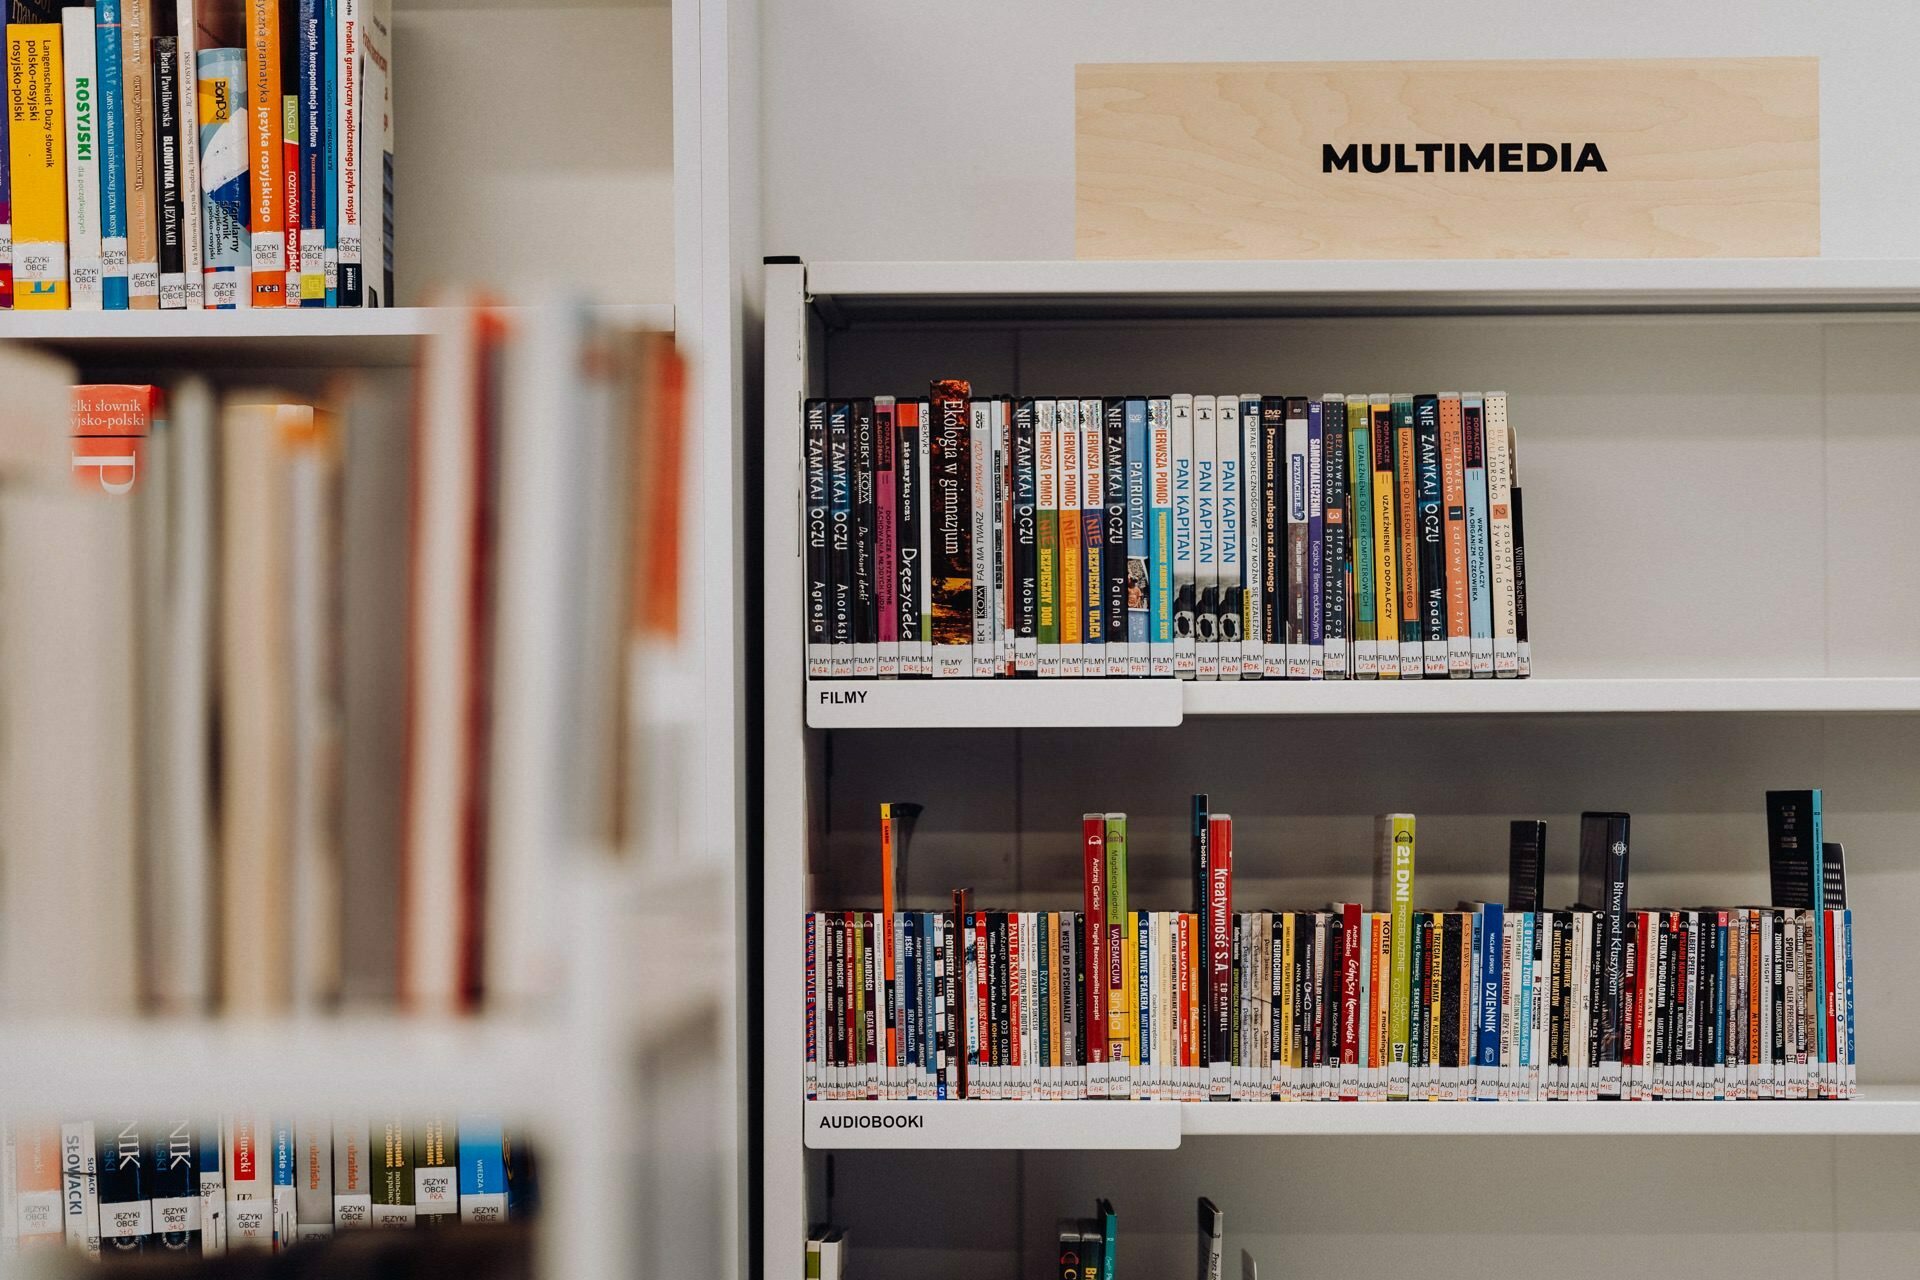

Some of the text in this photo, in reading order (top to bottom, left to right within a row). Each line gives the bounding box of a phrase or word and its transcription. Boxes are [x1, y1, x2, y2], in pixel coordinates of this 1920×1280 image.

[309, 19, 318, 50] Rosyjska
[346, 21, 355, 55] Poradnik
[11, 40, 25, 122] rosyjsko-polski
[26, 40, 40, 121] polsko-rosyjski
[42, 40, 55, 168] Langenscheidt Duży słownik
[308, 52, 318, 109] korespondencja
[345, 57, 355, 106] gramatyczny
[76, 77, 92, 161] ROSYJSKI
[256, 40, 273, 223] gramatyka języka rosyjskiego
[287, 100, 296, 134] LINGEA
[309, 111, 319, 147] handlowa
[345, 109, 357, 167] współczesnego
[160, 51, 176, 245] Beata Pawlikowska BLONDYNKA NA JĘZYKACH
[1322, 143, 1608, 173] MULTIMEDIA
[288, 170, 299, 223] rozmówki
[345, 168, 356, 194] języka
[215, 200, 223, 256] rosyjsko-polski
[231, 200, 240, 253] Popularny
[73, 268, 99, 276] JĘZYKI
[134, 280, 156, 288] OBCE
[95, 399, 141, 412] słownik
[859, 417, 870, 504] PROJEKT KOM
[937, 400, 964, 555] Ekologia w gimnazjum
[1249, 416, 1259, 529] PORTALE SPOŁECZNOŚCIOWE
[1265, 428, 1276, 480] Przemiana
[1310, 438, 1321, 518] SAMOOKALECZENIA
[832, 414, 847, 551] NIE ZAMYKAJ OCZU
[1064, 474, 1077, 507] POMOC
[1130, 462, 1144, 540] PATRIOTYZM
[1326, 460, 1334, 504] ZDROWO
[810, 410, 825, 632] NIE ZAMYKAJ OCZU Agresja
[1017, 408, 1034, 633] NIE ZAMYKAJ OCZU Mobbing
[1108, 408, 1123, 627] NIE ZAMYKAJ OCZU Palenie
[1176, 459, 1190, 561] PAN KAPITAN
[1199, 461, 1213, 564] PAN KAPITAN
[1222, 460, 1236, 563] PAN KAPITAN
[1266, 490, 1277, 530] grubego
[1401, 431, 1414, 609] UZALEŻNIENIE OD TELEFONU KOMÓRKOWEGO
[1421, 405, 1442, 640] NIE ZAMYKAJ OCZU Wpadka
[1267, 532, 1274, 544] na
[1312, 540, 1321, 567] Książka
[1382, 494, 1392, 619] UZALEŻNIENIE OD DOPALACZY
[1493, 525, 1503, 584] żywienia
[899, 548, 919, 639] Dręczyciele
[1040, 548, 1052, 626] BEZPIECZNY DOM
[1088, 547, 1101, 639] BEZPIECZNA ULICA
[1250, 587, 1259, 598] SIĘ
[1251, 555, 1260, 585] MOŻNA
[1265, 546, 1276, 593] zdrowego
[1313, 573, 1321, 594] filmem
[1515, 546, 1525, 616] William Szekspir
[1015, 652, 1037, 660] FILMY
[820, 691, 868, 704] FILMY
[1110, 850, 1121, 984] Magdalena Giedrojć VADEMECUM
[1396, 845, 1410, 972] 21 DNI PRZEBUDZENIE
[1009, 923, 1019, 996] PAUL EKMAN
[1091, 858, 1101, 1020] Andrzej Garlicki Drugiej Rzeczypospolitej początki
[1211, 868, 1229, 1033] Kreatywność S.A. ED CATMULL
[1382, 921, 1390, 955] KOTLER
[1608, 881, 1624, 996] Bitwa pod Kłuszynem
[1625, 942, 1634, 978] KALIGULA
[1061, 930, 1072, 1024] WSTĘP DO PSYCHOANALIZY
[1656, 934, 1668, 1008] SZTUKA PODGLĄDANIA
[1485, 982, 1497, 1033] DZIENNIK
[819, 1116, 923, 1128] AUDIOBOOKI
[66, 1135, 83, 1216] SŁOWACKI
[87, 1157, 95, 1195] SŁOWACKI
[422, 1178, 449, 1187] JĘZYKI
[424, 1185, 447, 1194] OBCE
[113, 1212, 141, 1223] JĘZYKI
[116, 1219, 139, 1228] OBCE
[161, 1206, 188, 1216] JĘZYKI
[164, 1214, 186, 1223] OBCE
[236, 1213, 263, 1223] JĘZYKI
[238, 1220, 261, 1229] OBCE
[338, 1205, 365, 1215] JĘZYKI
[340, 1213, 363, 1221] OBCE
[472, 1207, 499, 1216] JĘZYKI
